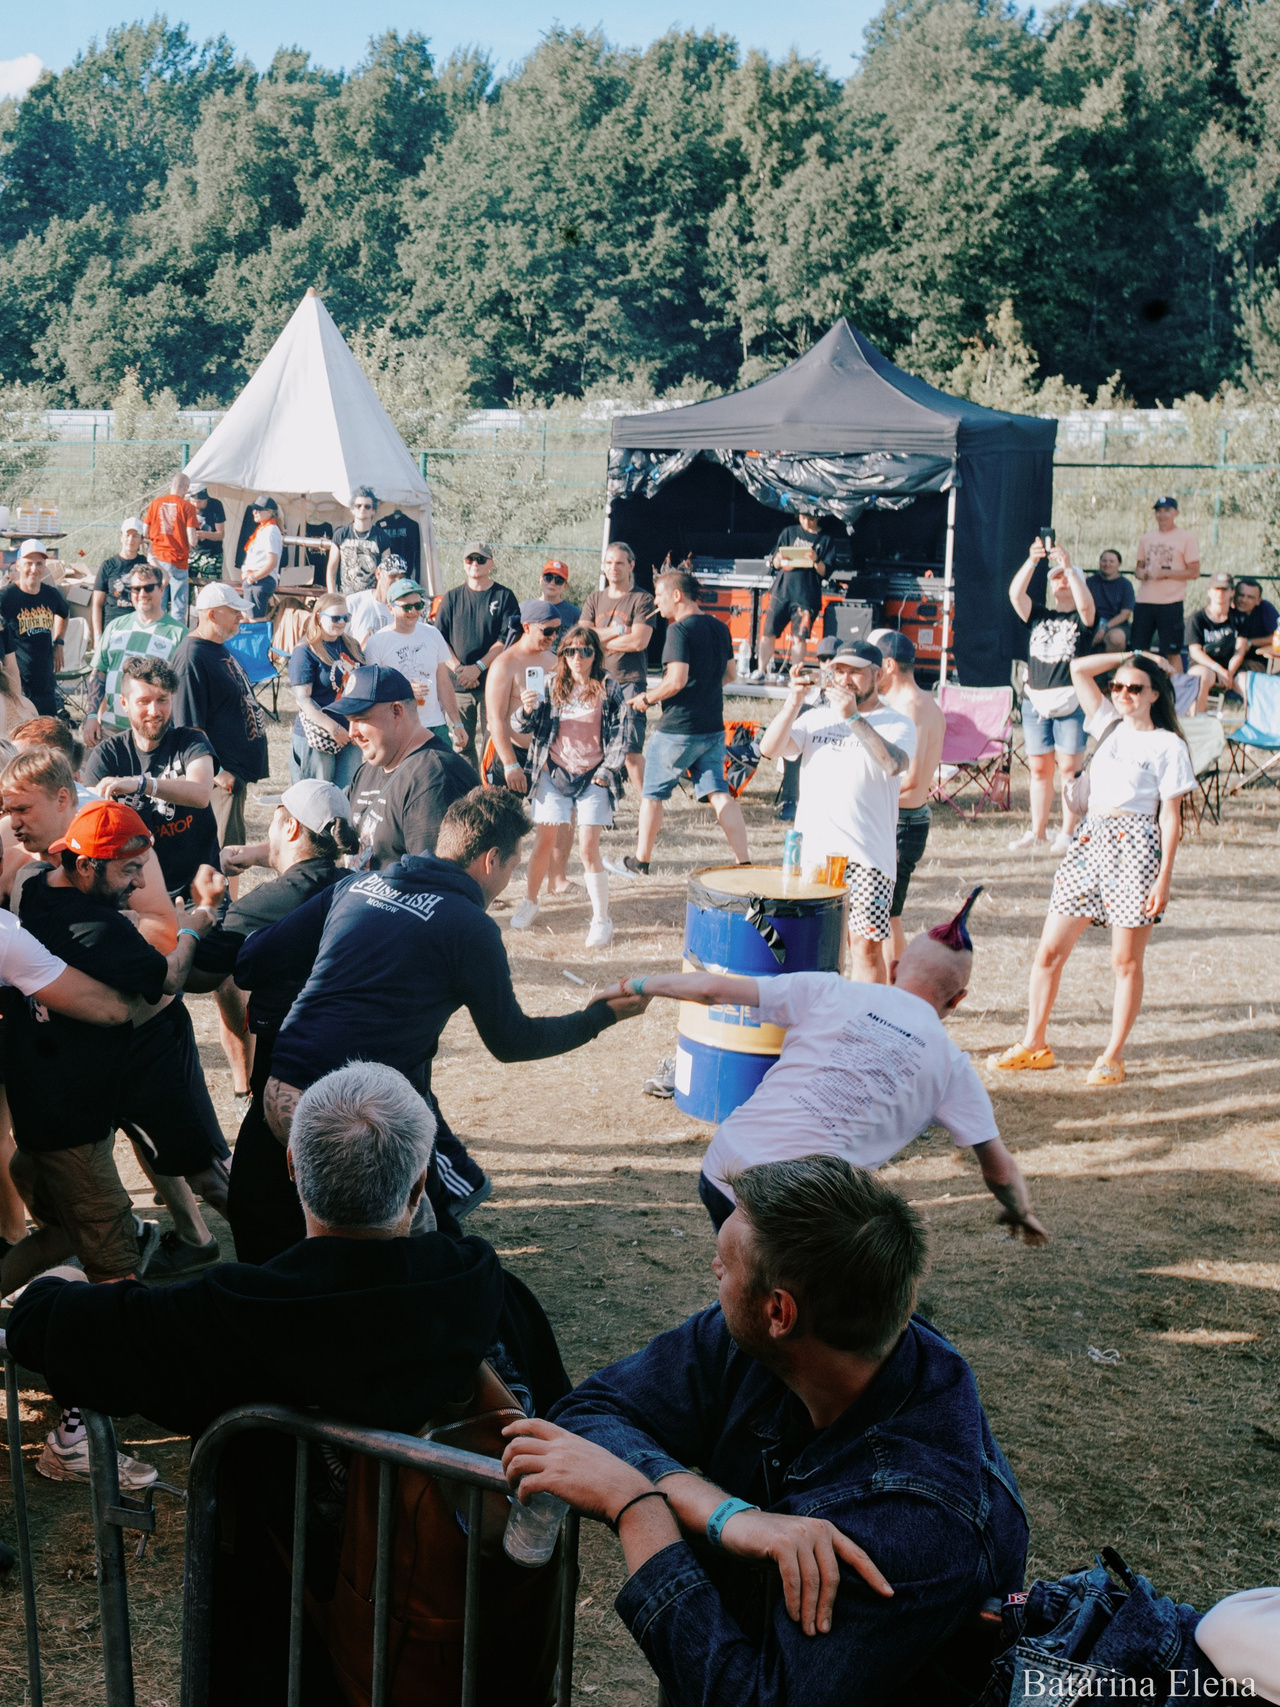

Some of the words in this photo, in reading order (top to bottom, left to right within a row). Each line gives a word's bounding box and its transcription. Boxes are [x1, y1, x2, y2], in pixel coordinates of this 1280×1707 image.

[356, 873, 402, 900] PLUSH
[398, 893, 444, 915] FISH
[366, 897, 400, 914] MOSCOW
